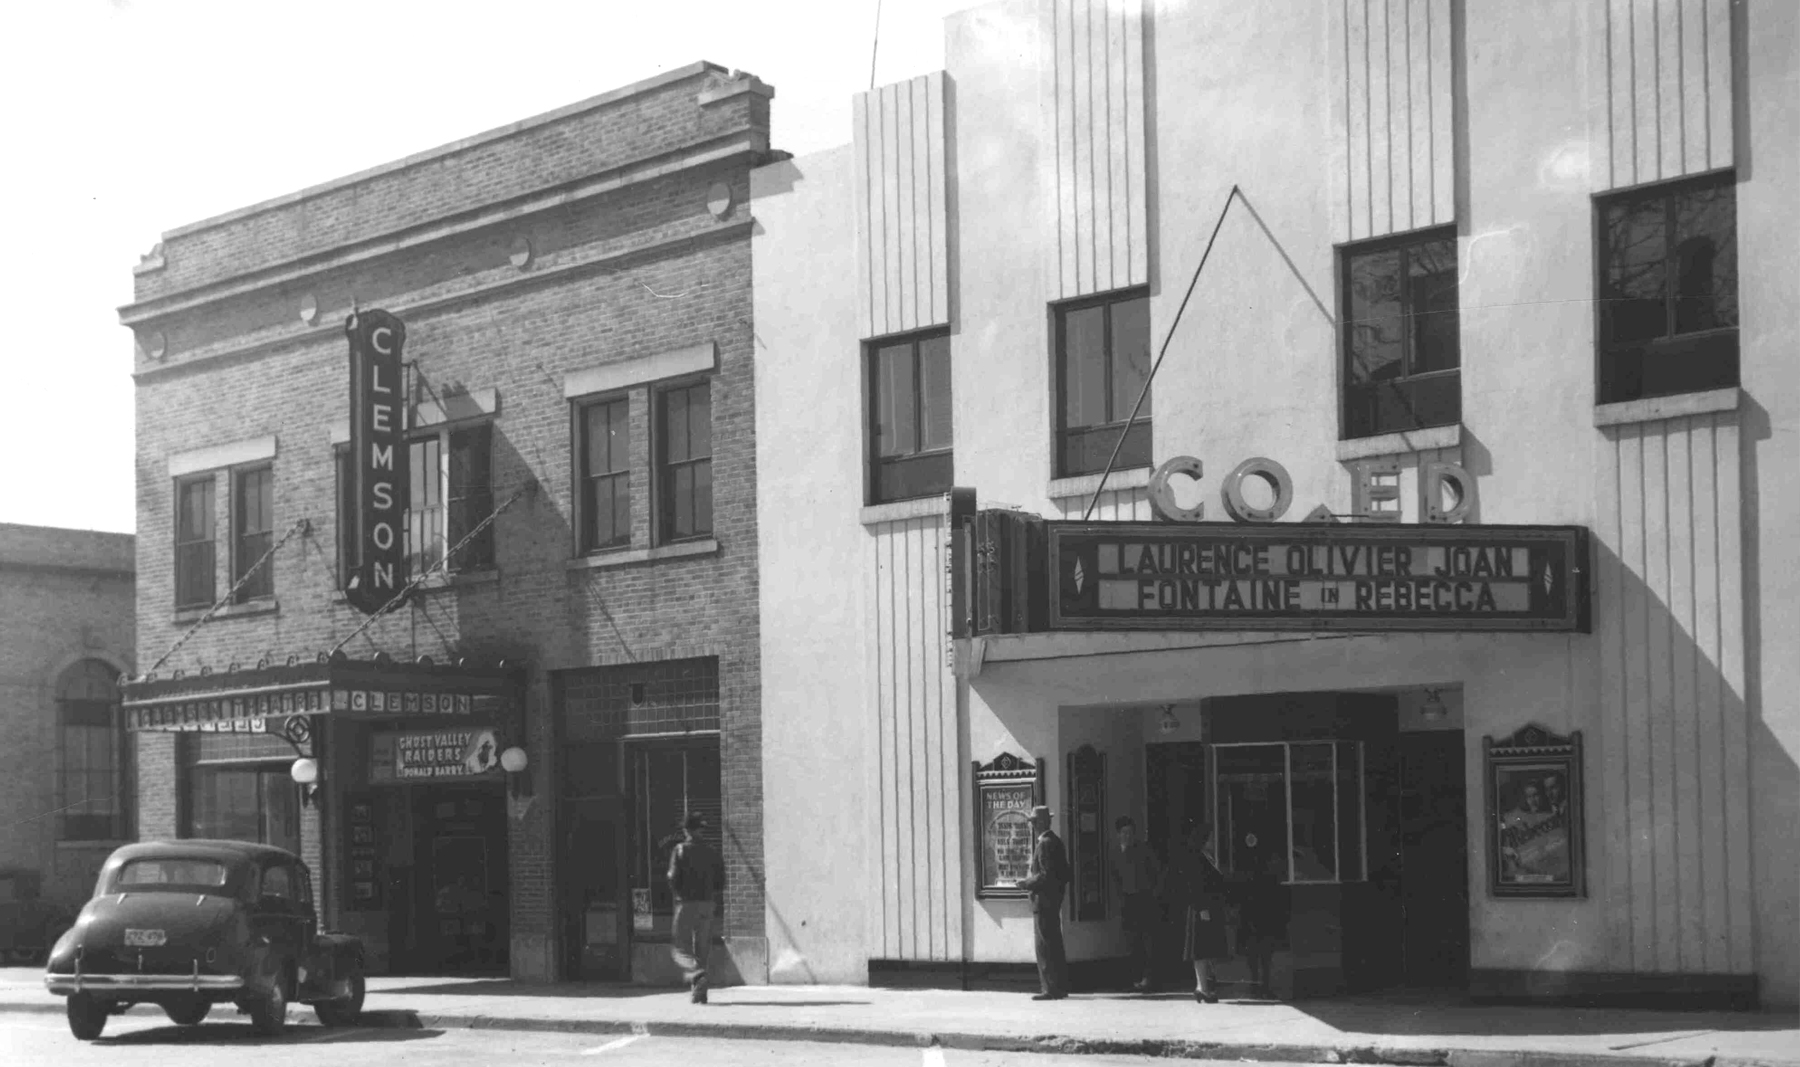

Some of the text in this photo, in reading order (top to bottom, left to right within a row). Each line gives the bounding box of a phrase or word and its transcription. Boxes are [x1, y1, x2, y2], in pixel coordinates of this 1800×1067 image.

[371, 327, 394, 589] CLEMSON
[1119, 544, 1512, 577] LAURENCE OLIVIER JOAN
[1138, 580, 1497, 611] FONTAINE IN REBECCA
[233, 692, 318, 718] THEATRE
[353, 693, 471, 713] CLEMSON
[400, 732, 471, 749] GHOST VALLEY
[404, 748, 461, 761] RAIDERS
[986, 791, 1025, 800] NEWS OF
[987, 800, 1025, 809] THE DAY
